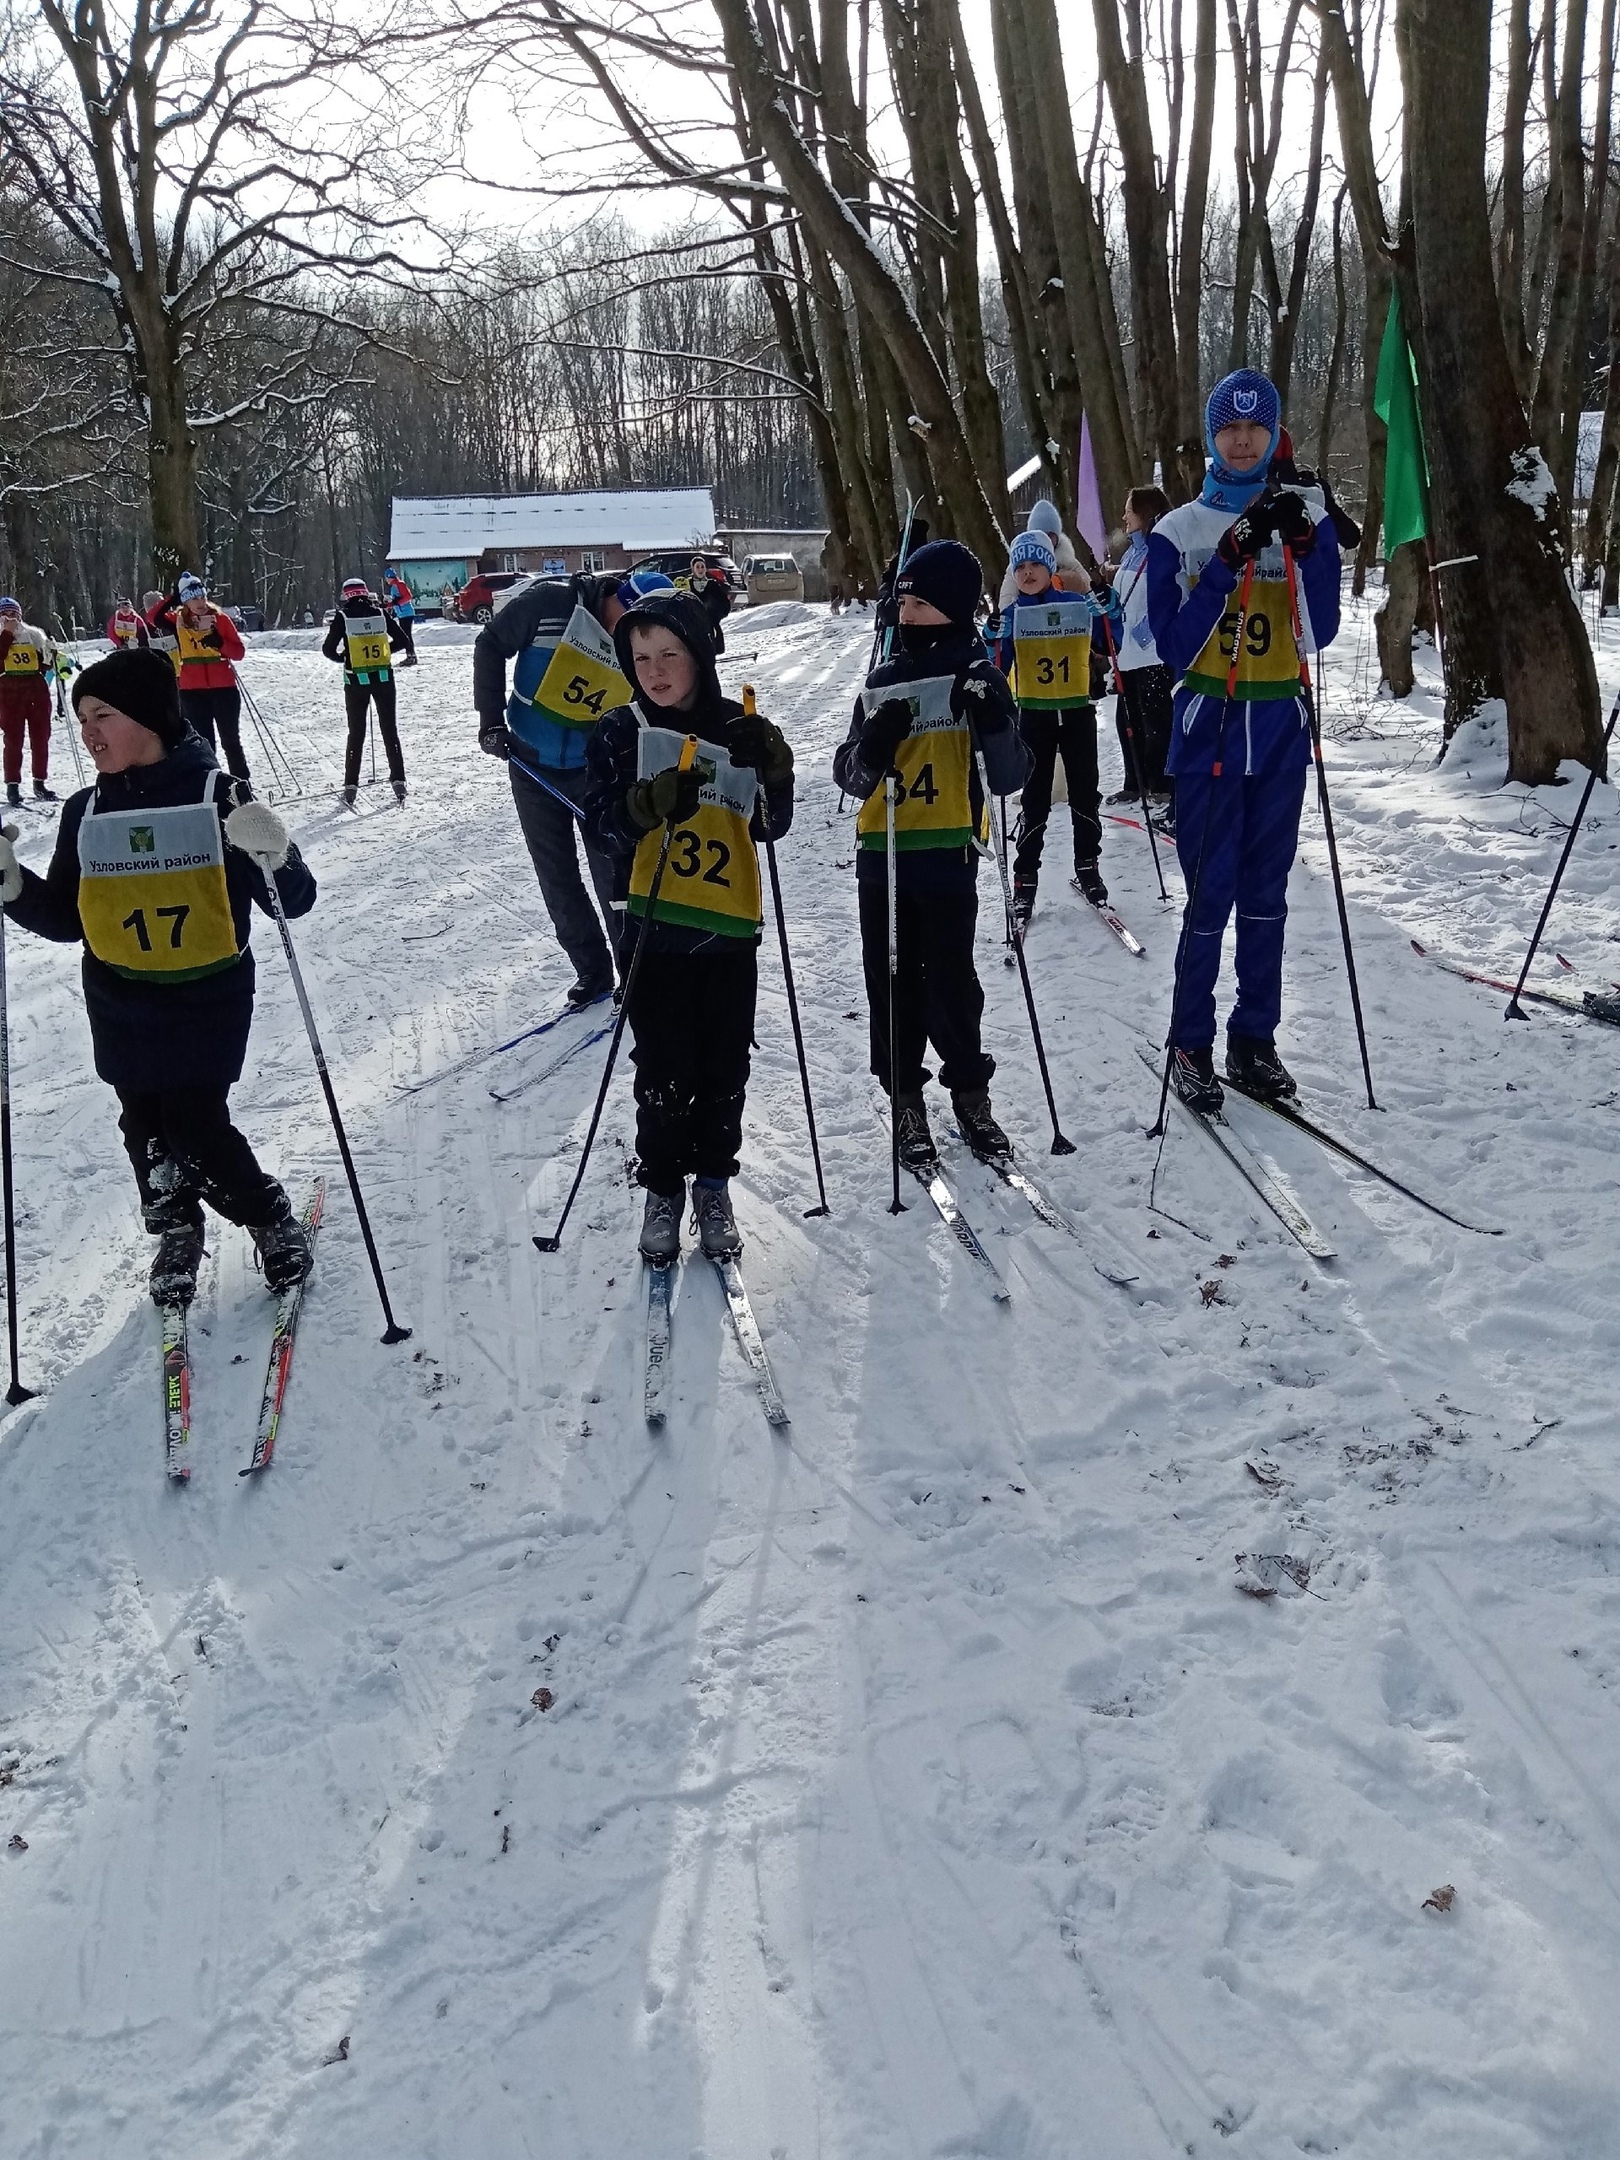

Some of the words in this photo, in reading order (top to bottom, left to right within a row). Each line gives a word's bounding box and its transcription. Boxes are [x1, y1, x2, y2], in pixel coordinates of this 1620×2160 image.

[1064, 626, 1086, 637] район
[1217, 612, 1271, 657] 59
[1232, 610, 1245, 663] MADSHUS
[12, 652, 31, 665] 38
[362, 645, 380, 659] 15
[569, 635, 612, 665] Узловский
[1036, 655, 1070, 685] 31
[562, 675, 608, 716] 54
[89, 857, 160, 873] Узловский
[164, 851, 211, 871] район
[670, 830, 731, 889] 32
[121, 904, 191, 952] 17
[168, 1375, 181, 1408] SABLE
